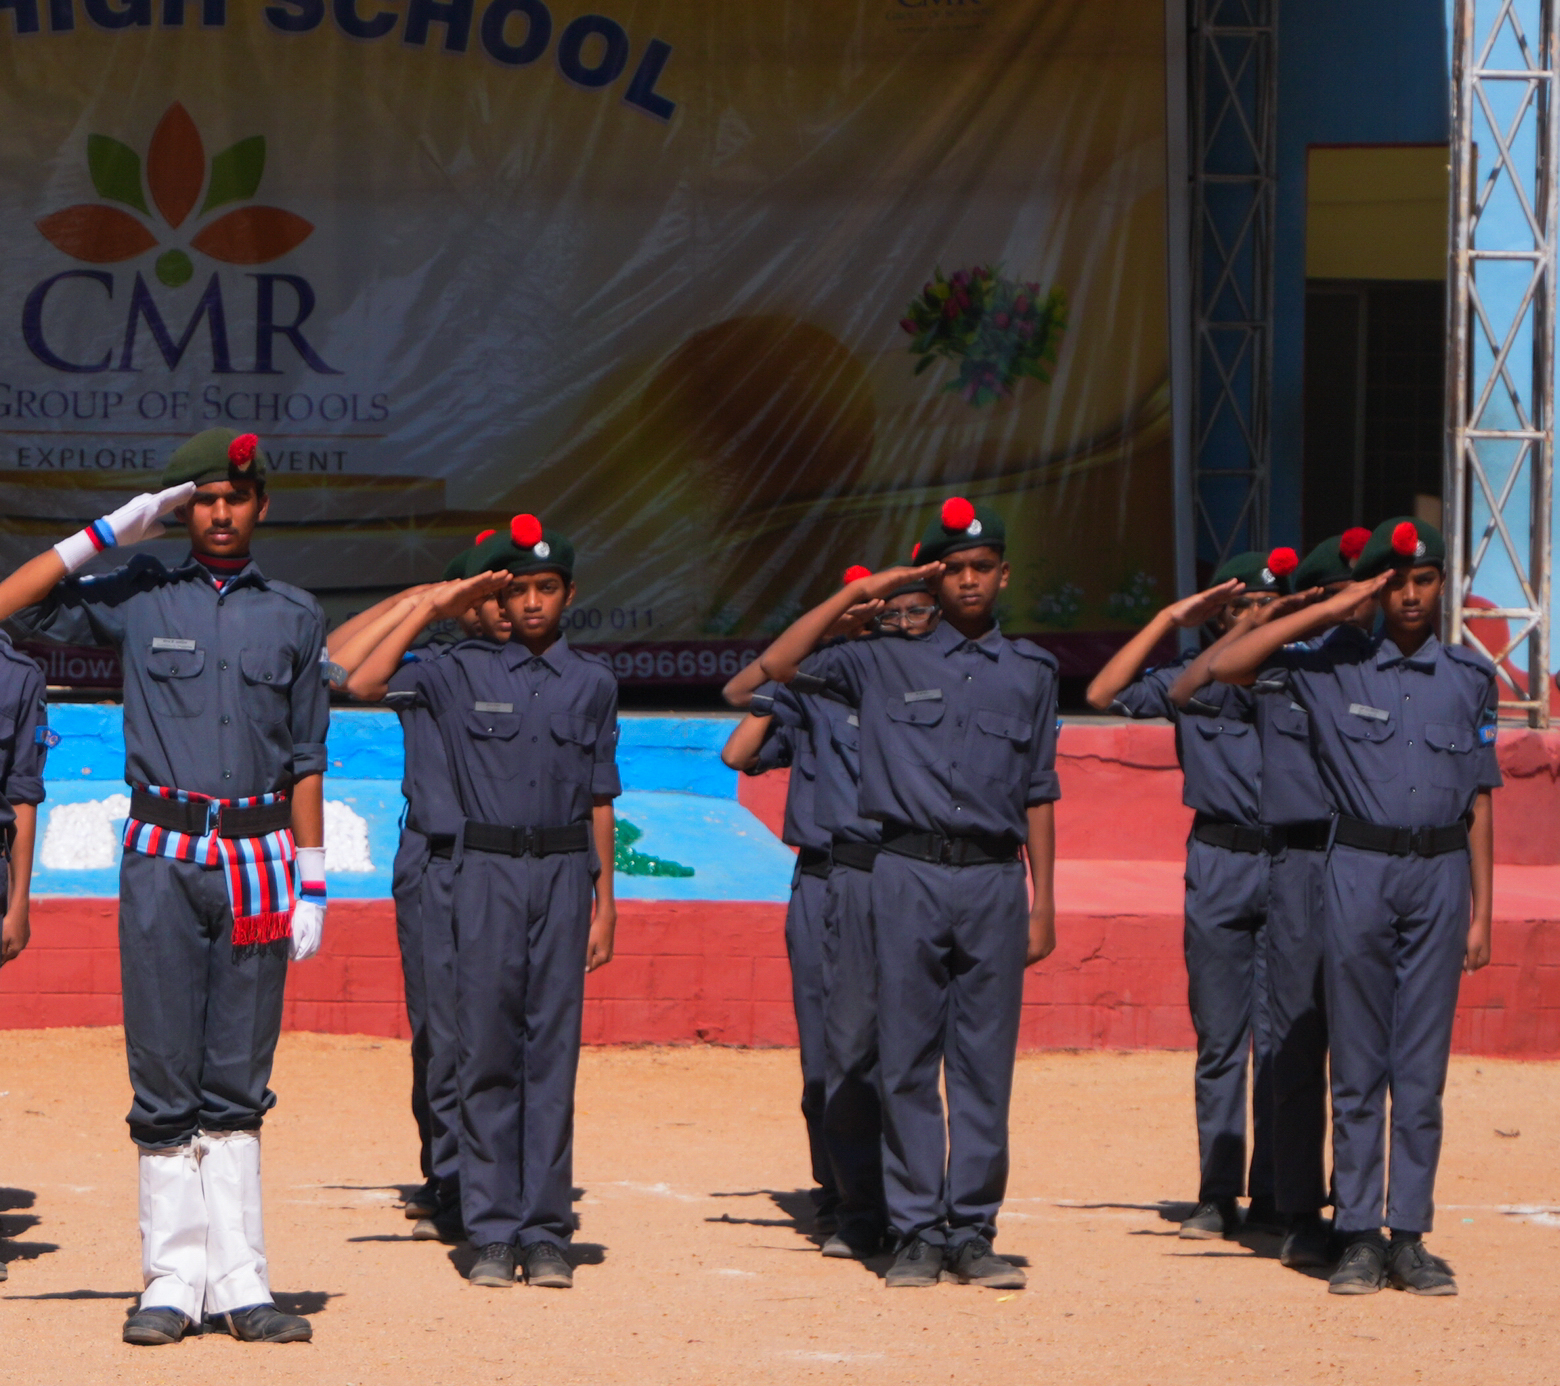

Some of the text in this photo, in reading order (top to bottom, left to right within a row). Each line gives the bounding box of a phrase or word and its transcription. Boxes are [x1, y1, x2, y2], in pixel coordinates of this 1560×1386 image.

[21, 268, 345, 375] CMR
[137, 390, 189, 420] OF
[203, 384, 390, 423] SCHOOLS
[17, 446, 156, 470] EXPLORE
